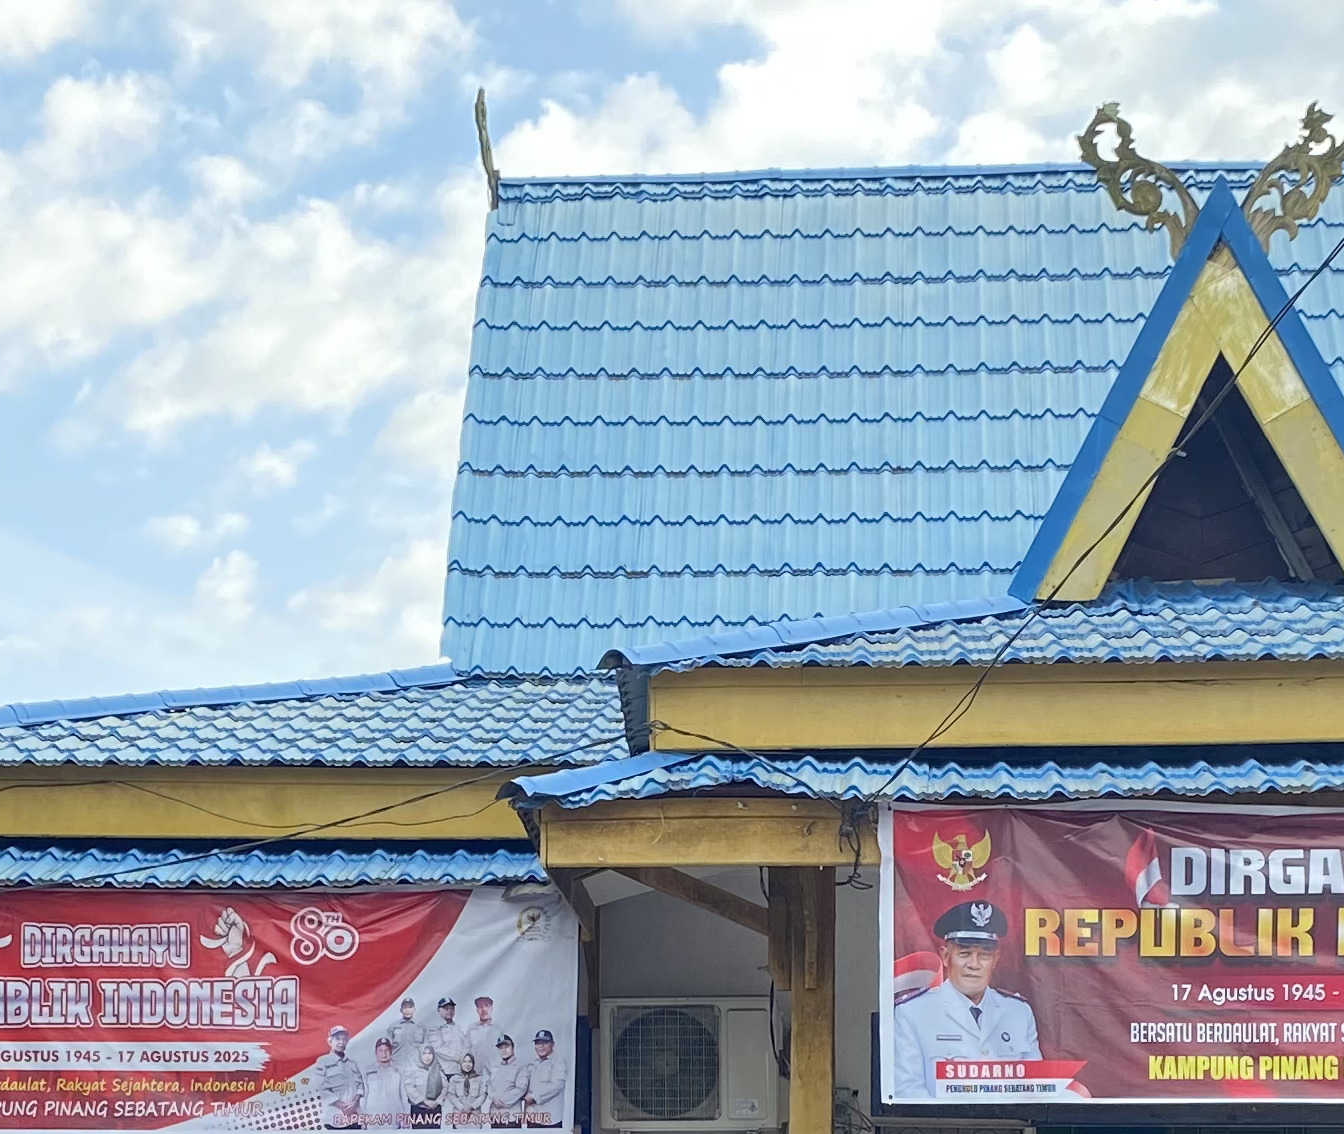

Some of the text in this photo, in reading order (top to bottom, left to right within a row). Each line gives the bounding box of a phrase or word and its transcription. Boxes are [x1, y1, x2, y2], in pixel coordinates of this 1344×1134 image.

[290, 907, 359, 965] 80
[1024, 907, 1315, 957] REPUBLIK
[21, 922, 191, 968] DIRGAHAYU
[98, 975, 299, 1032] INDONESIA
[1171, 983, 1193, 1001] 17
[1197, 983, 1275, 1006] Agustus
[1281, 983, 1326, 1001] 1945
[1130, 1022, 1193, 1043] BERSATU
[1196, 1022, 1280, 1046] BERDAULAT,
[1283, 1022, 1338, 1043] RAKYAT
[66, 1050, 101, 1063] 1945
[118, 1050, 135, 1063] 17
[140, 1050, 209, 1063] AGUSTUS
[213, 1050, 249, 1063] 2025
[1148, 1055, 1255, 1080] KAMPUNG
[1258, 1055, 1340, 1080] PINANG
[944, 1063, 1026, 1079] SUDARNO
[56, 1078, 107, 1096] Rakyat
[111, 1078, 185, 1096] Sejahtera,
[190, 1077, 256, 1092] Indonesia
[261, 1078, 297, 1096] Maju
[44, 1100, 108, 1117] PINANG
[113, 1101, 205, 1117] SEBATANG
[211, 1101, 265, 1118] TIMUR
[333, 1111, 554, 1126] BAPEKAM PINANG SEBATANG TIMUR
